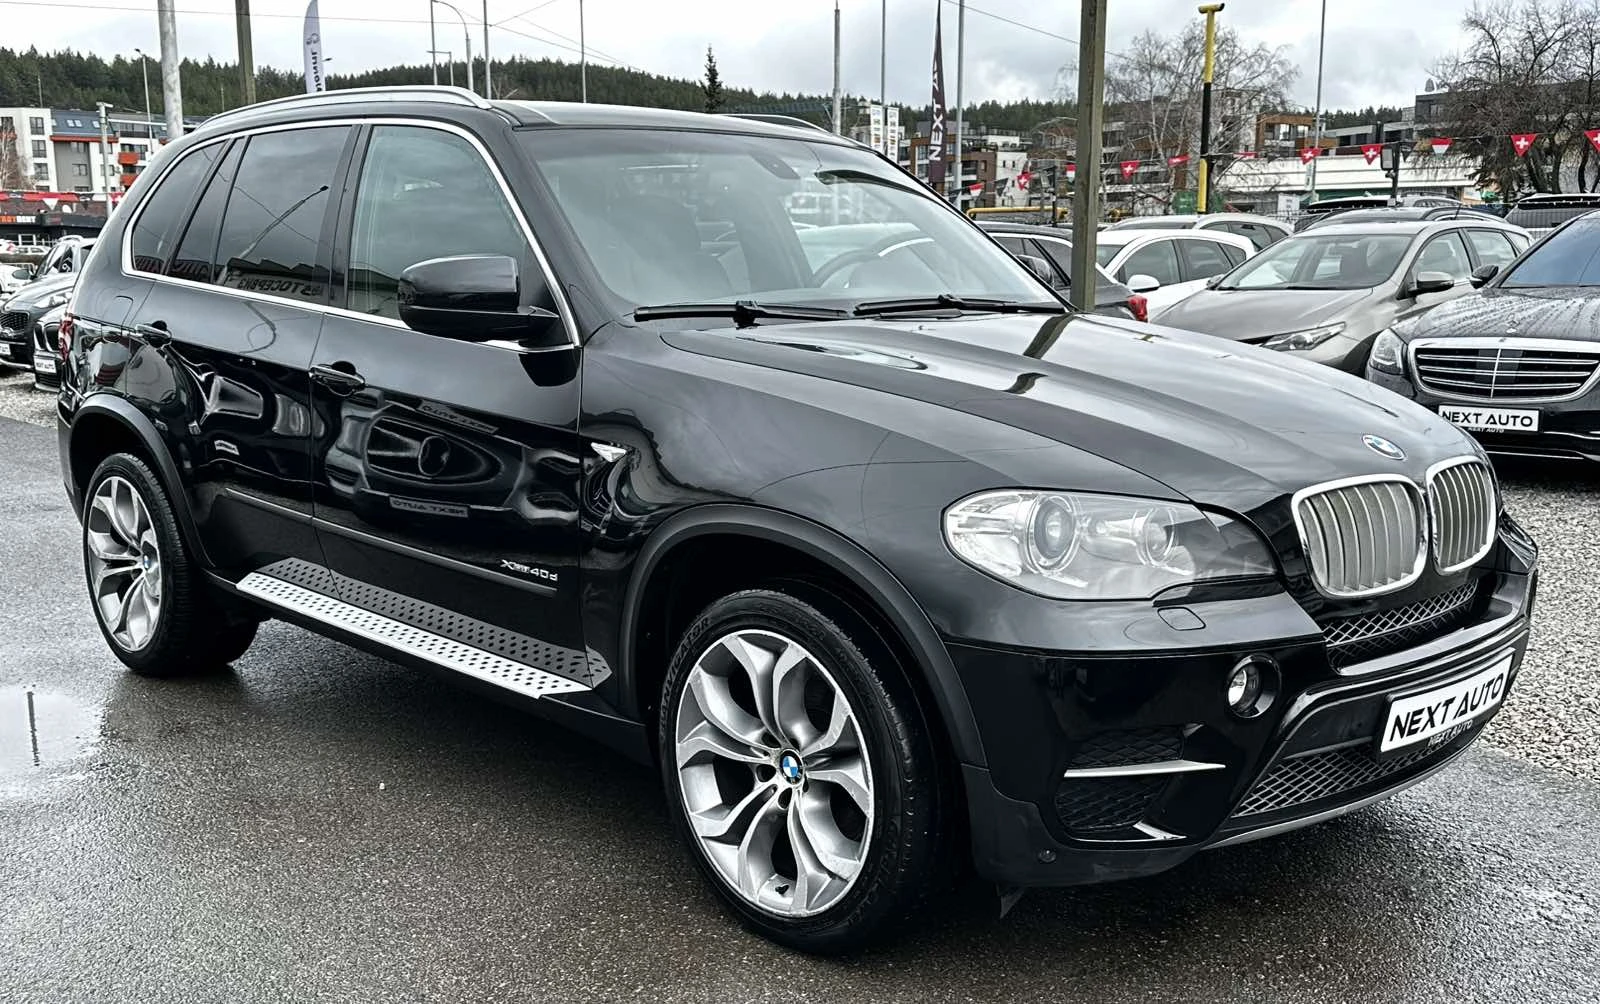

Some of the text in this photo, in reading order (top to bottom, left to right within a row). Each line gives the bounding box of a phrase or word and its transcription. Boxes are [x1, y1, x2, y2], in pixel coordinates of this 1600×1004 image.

[928, 98, 943, 160] NEXT
[1442, 411, 1533, 427] NEXT AUTO
[1390, 673, 1504, 742] NEXT AUTO
[1428, 719, 1473, 747] NEXT AUTO
